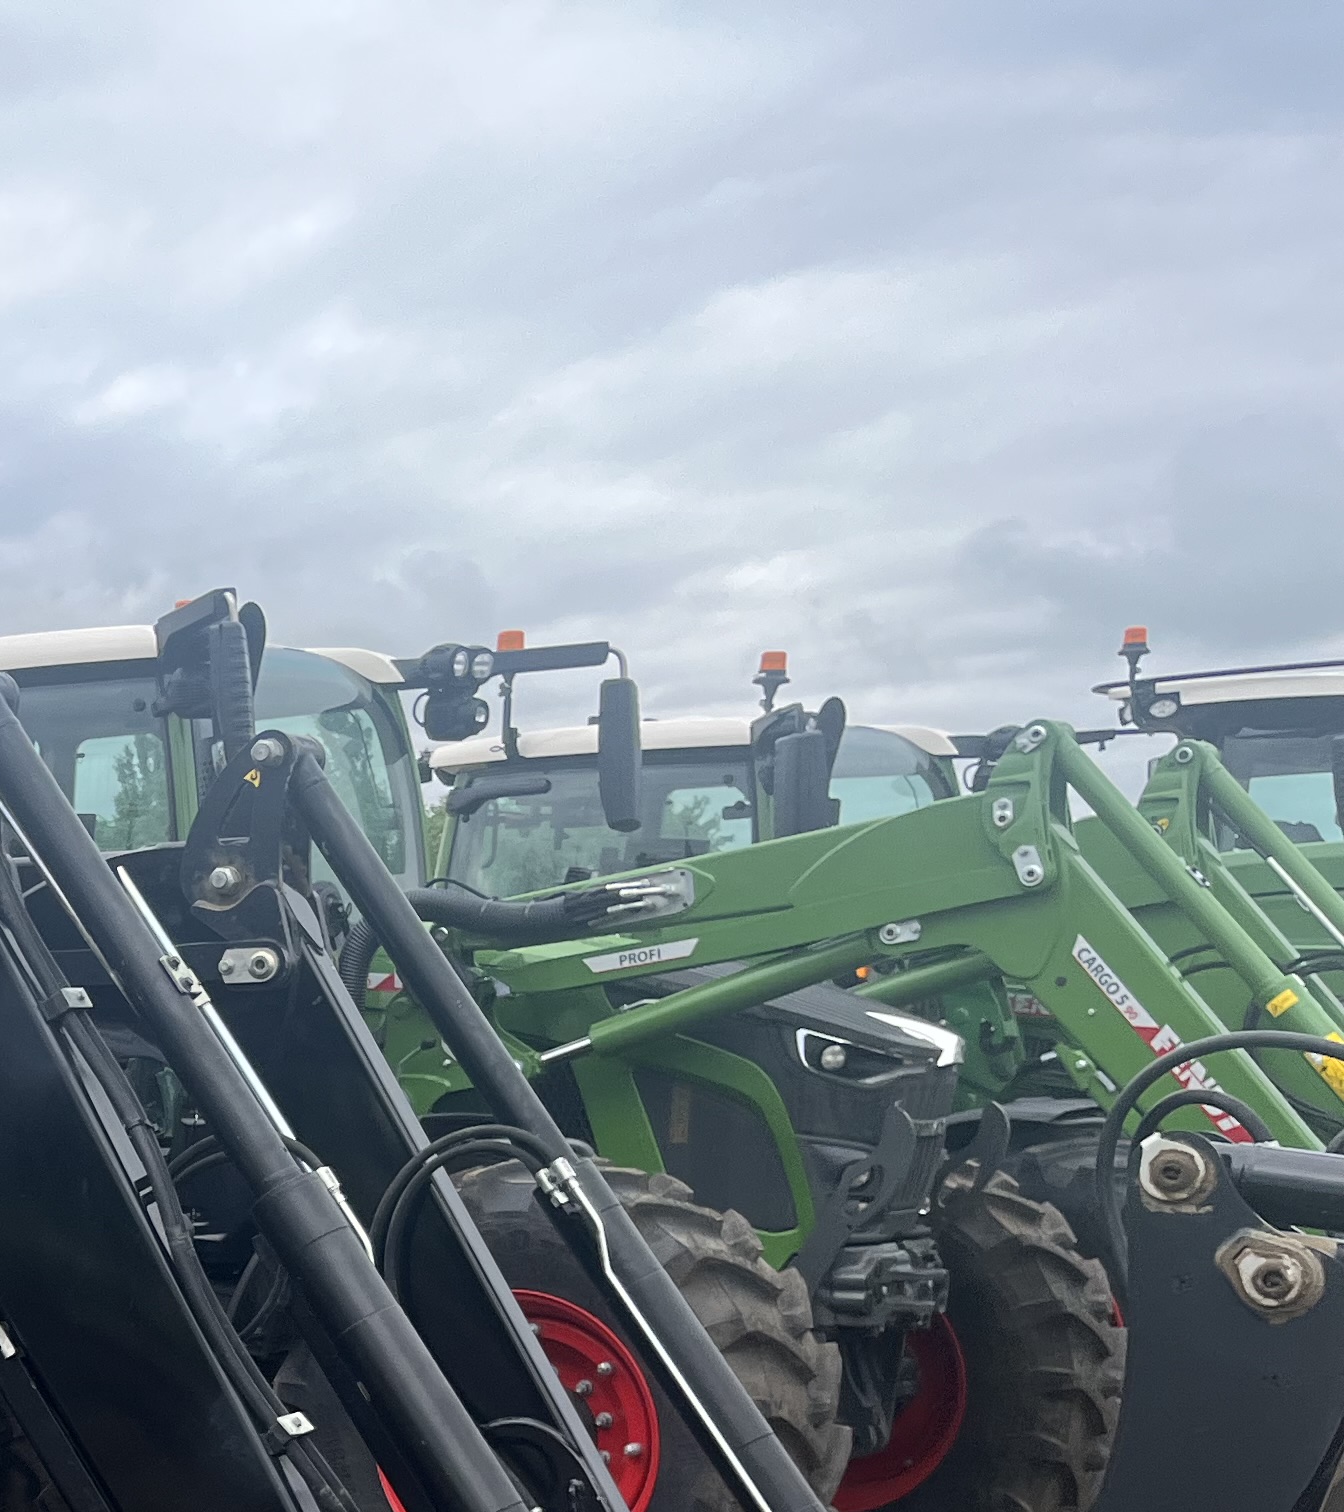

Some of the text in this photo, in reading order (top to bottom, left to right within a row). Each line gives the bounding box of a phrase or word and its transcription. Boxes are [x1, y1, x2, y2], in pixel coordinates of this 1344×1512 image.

[618, 948, 662, 966] PROFI
[1077, 947, 1120, 995] CARGO
[1115, 994, 1130, 1006] 5
